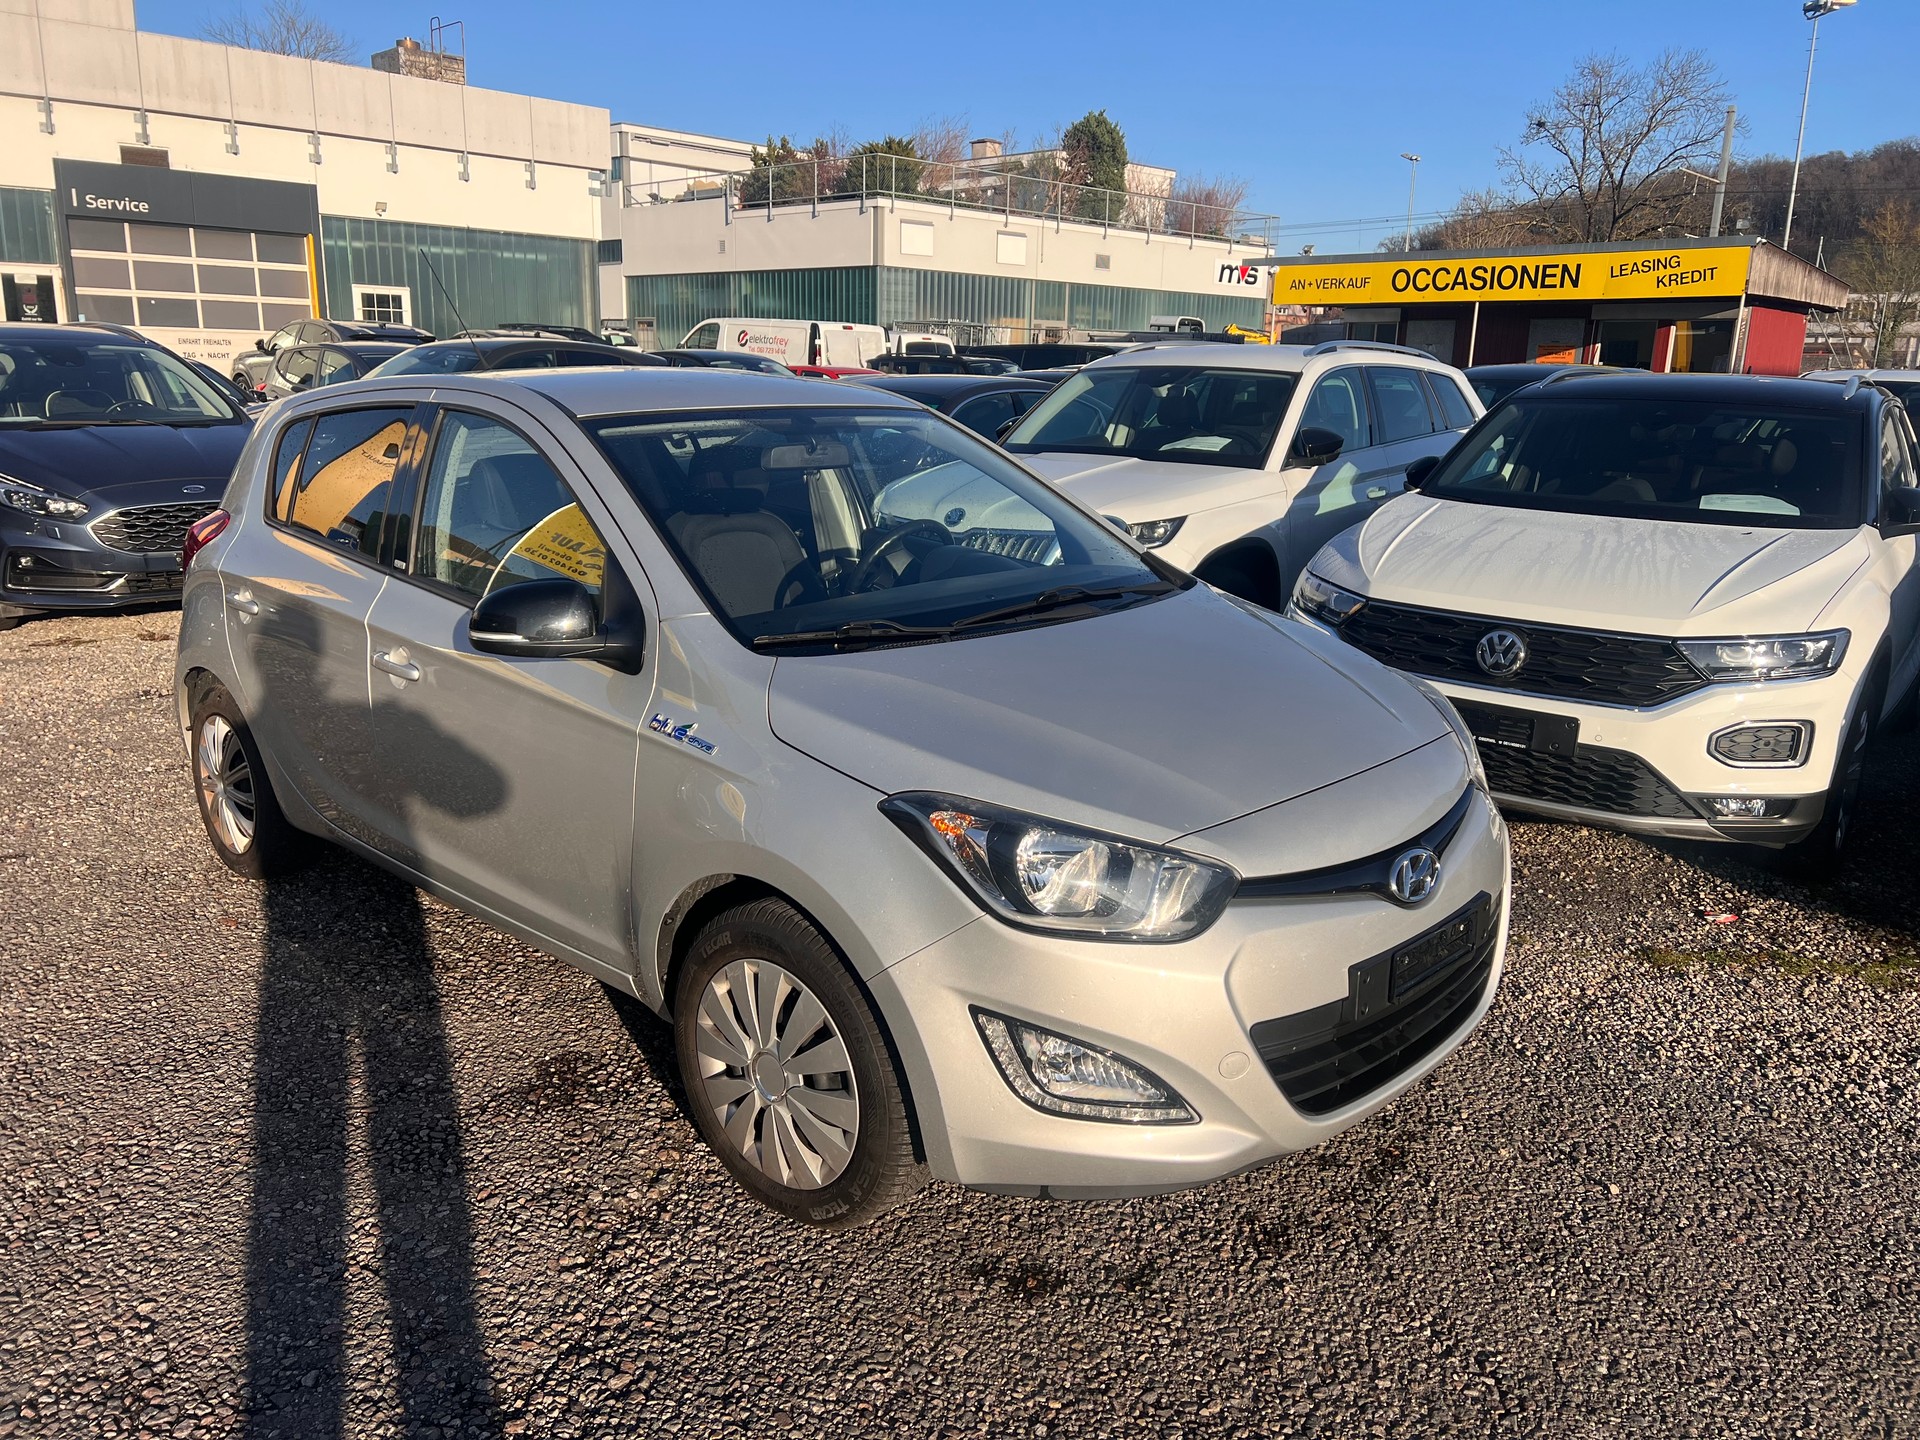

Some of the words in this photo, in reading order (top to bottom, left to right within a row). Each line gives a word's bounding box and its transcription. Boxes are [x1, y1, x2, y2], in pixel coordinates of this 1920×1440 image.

[85, 194, 149, 213] Service
[1391, 263, 1582, 293] OCCASIONEN
[1610, 255, 1681, 279] LEASING
[1655, 266, 1718, 289] KREDIT
[1290, 279, 1306, 290] AN
[1315, 277, 1371, 290] VERKAUF
[178, 338, 201, 346] EINFAHRT
[749, 334, 789, 347] elektrofrey
[649, 713, 688, 743] blue
[700, 931, 733, 959] TECAR
[808, 1198, 850, 1221] TECAR
